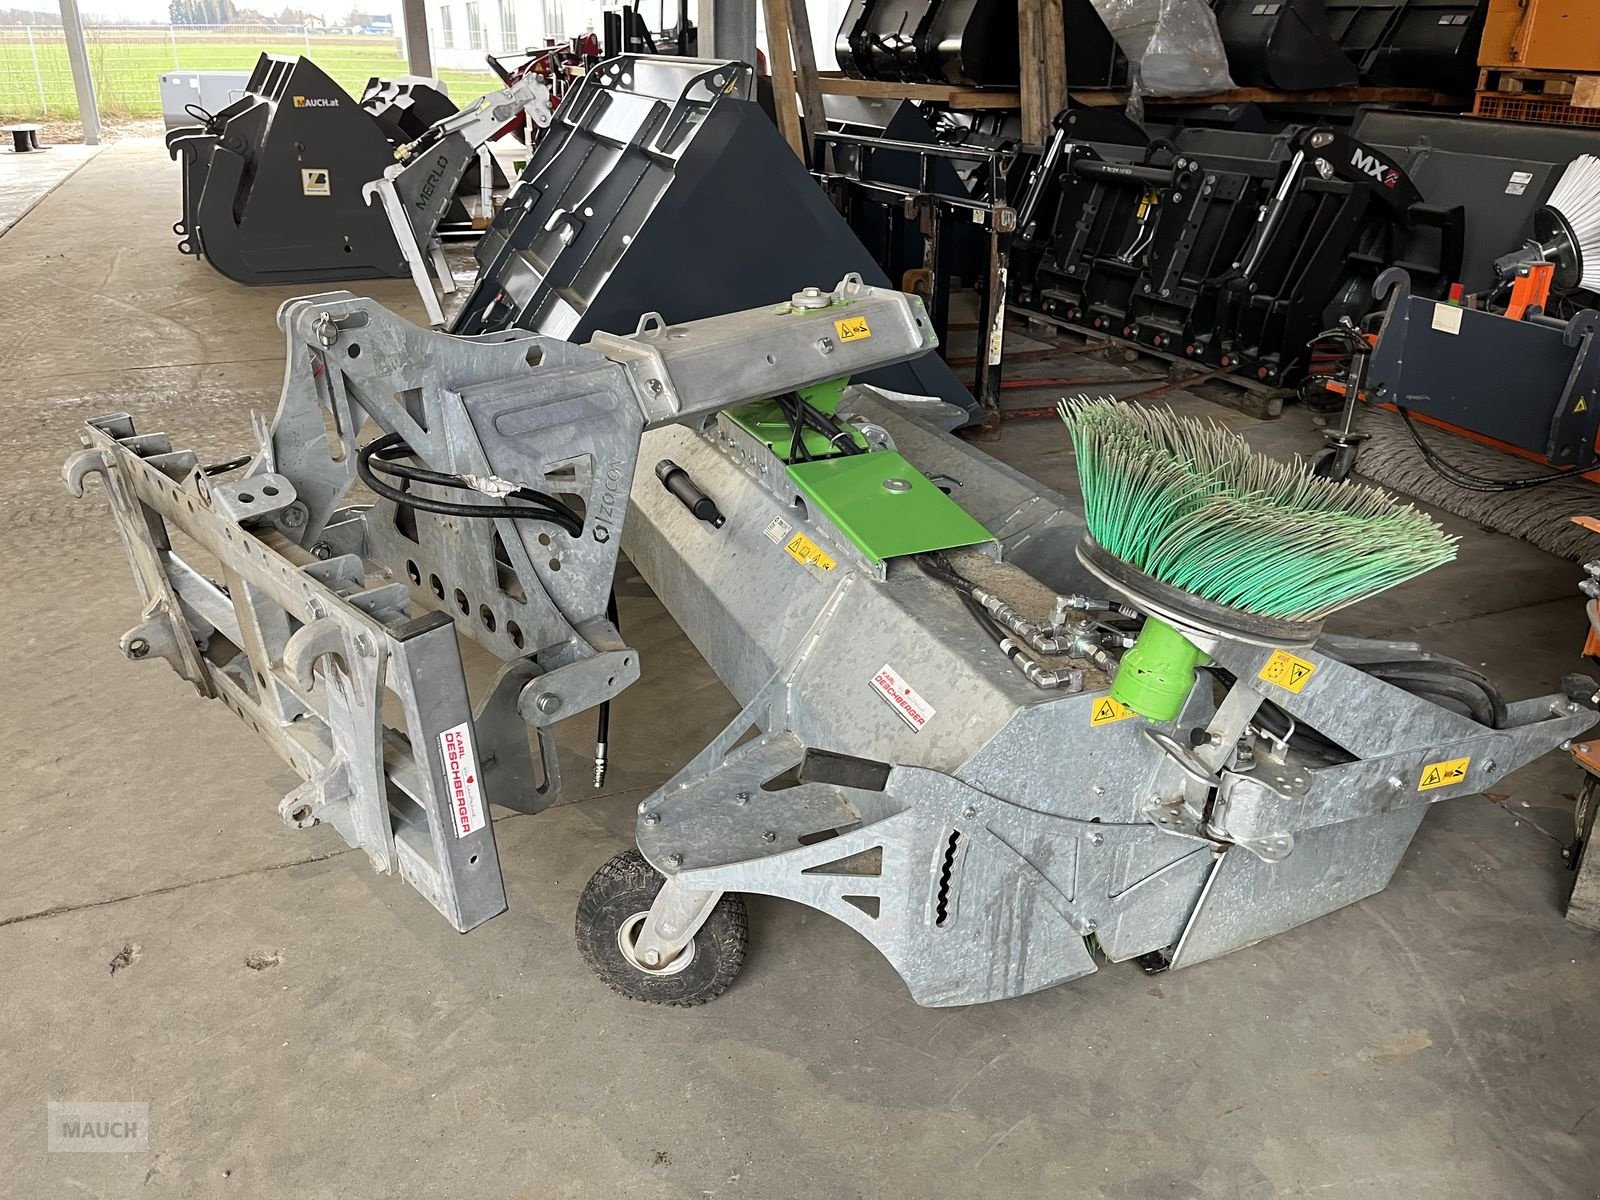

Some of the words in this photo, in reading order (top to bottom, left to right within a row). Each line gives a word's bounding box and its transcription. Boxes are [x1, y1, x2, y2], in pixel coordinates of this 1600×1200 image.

[415, 155, 449, 211] MERLO
[875, 675, 925, 726] DESCHBERGER
[882, 671, 896, 686] KARL
[455, 731, 465, 759] KARL
[445, 732, 471, 833] DESCHBERGER
